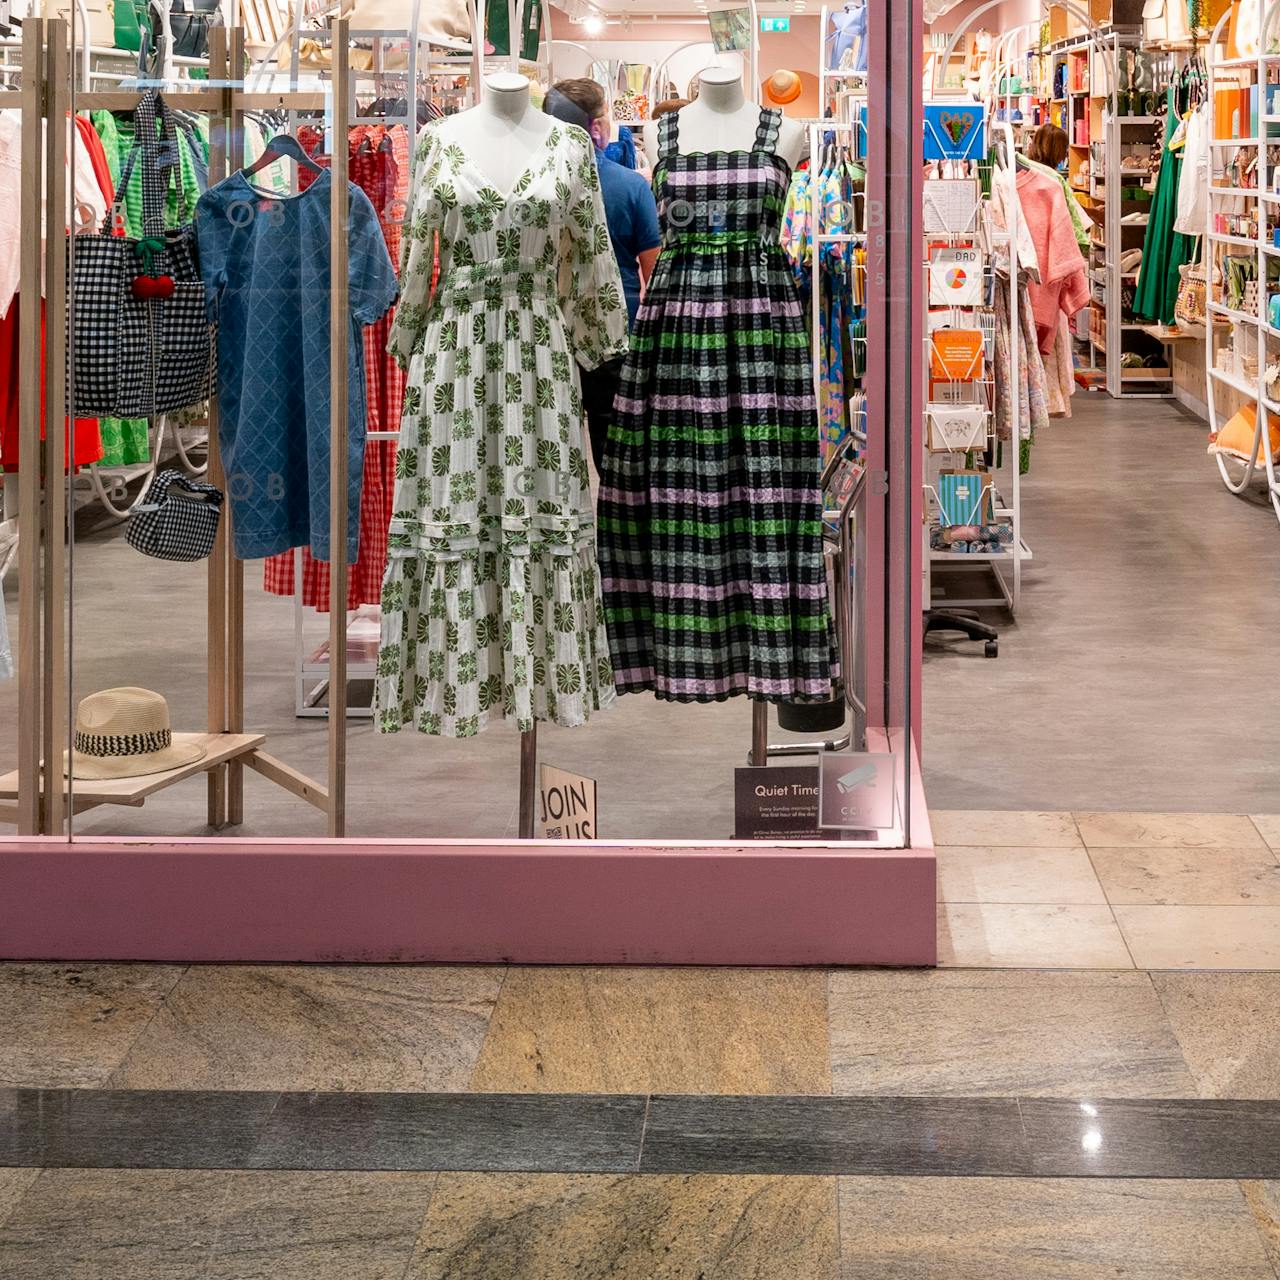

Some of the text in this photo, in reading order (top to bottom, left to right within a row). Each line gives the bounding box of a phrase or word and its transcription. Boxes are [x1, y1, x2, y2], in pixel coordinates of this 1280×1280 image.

[955, 251, 977, 262] DAD
[754, 784, 820, 797] Quiet Time
[540, 781, 588, 823] JOIN
